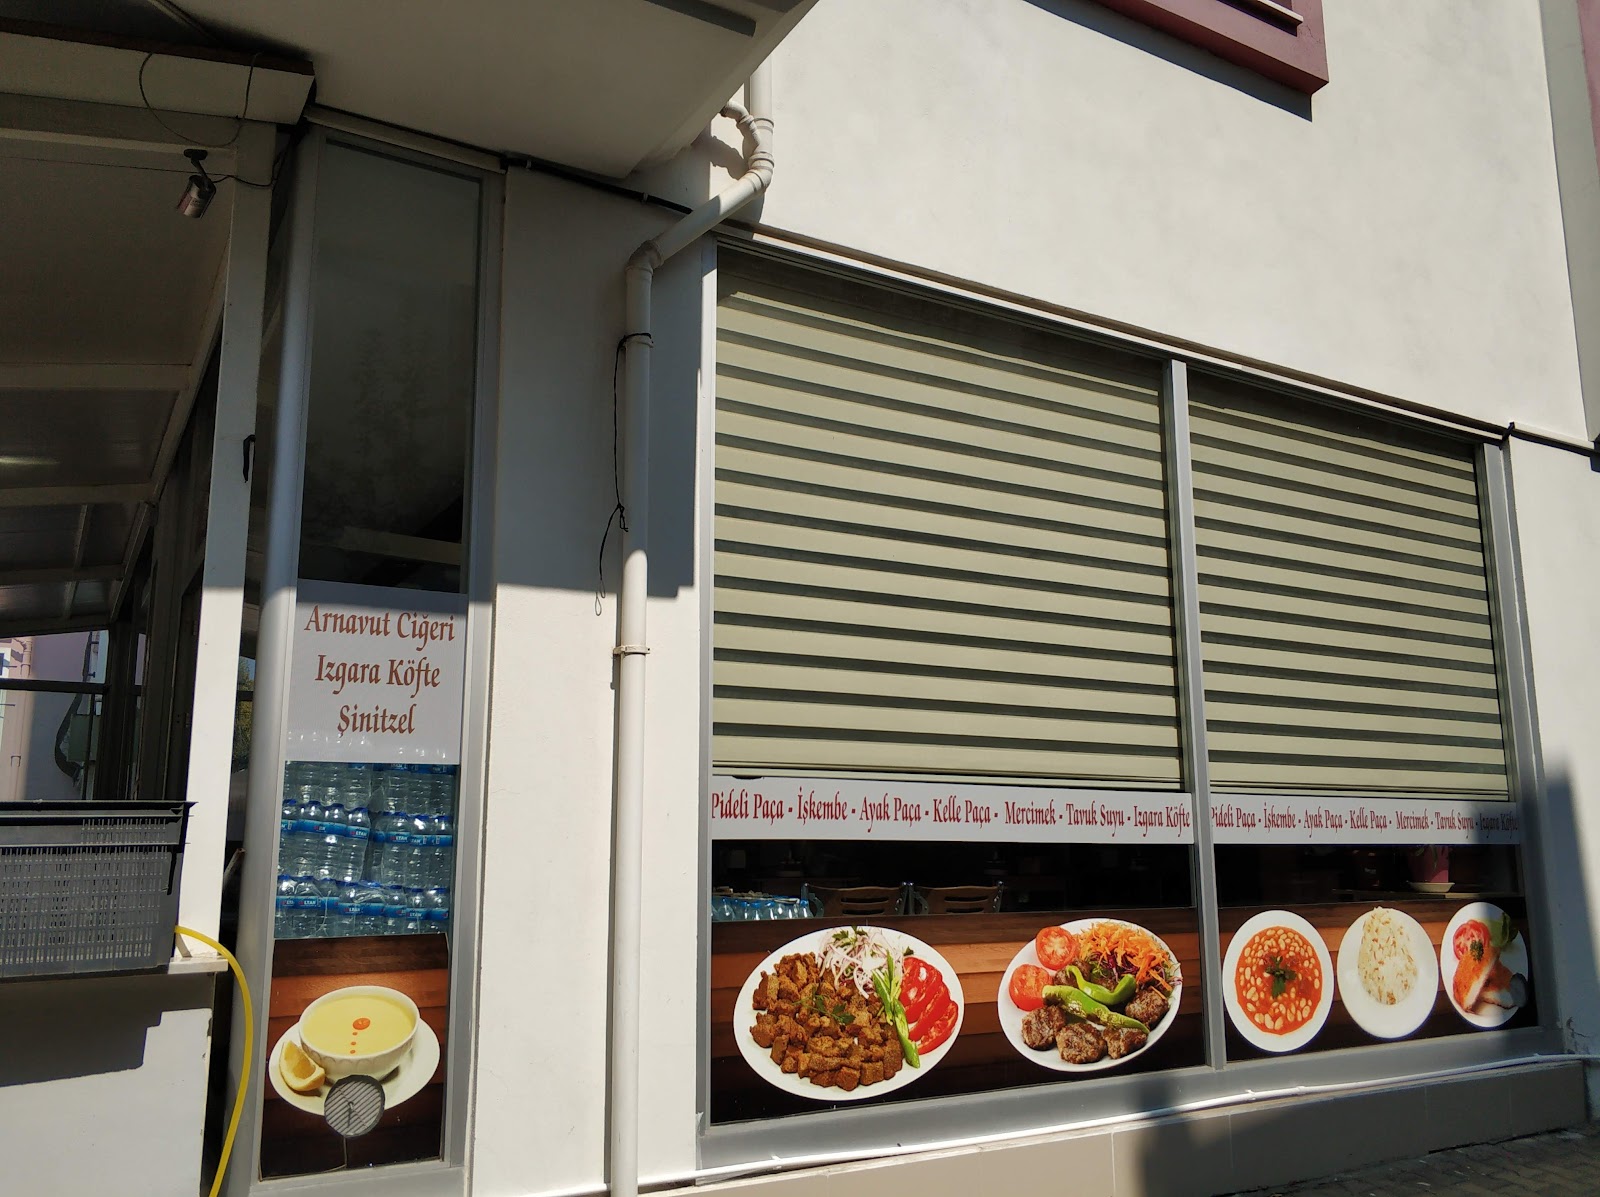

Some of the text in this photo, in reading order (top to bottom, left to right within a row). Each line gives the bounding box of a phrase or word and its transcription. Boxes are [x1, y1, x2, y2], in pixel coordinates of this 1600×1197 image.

[304, 605, 455, 651] Arnavut Ciğeri
[314, 654, 440, 698] Izgara Köfte
[337, 703, 417, 738] Şinitzel
[711, 788, 749, 820] Pideli
[753, 793, 784, 825] Paça
[797, 786, 848, 825] İşkembe
[859, 793, 891, 833] Ayak
[893, 797, 922, 827] Paça
[932, 795, 961, 823] Kelle
[964, 799, 991, 829] Paça
[1004, 799, 1057, 825] Mercimek
[1065, 801, 1098, 826] Tavuk
[1100, 804, 1125, 837] Suyu
[1133, 806, 1163, 837] Izgara
[1165, 803, 1190, 838] Köfte
[1235, 807, 1256, 833] Paça
[1263, 802, 1297, 833] İşkembe
[1303, 806, 1324, 838] Ayak
[1324, 809, 1343, 833] Paça
[1349, 806, 1369, 829] Kelle
